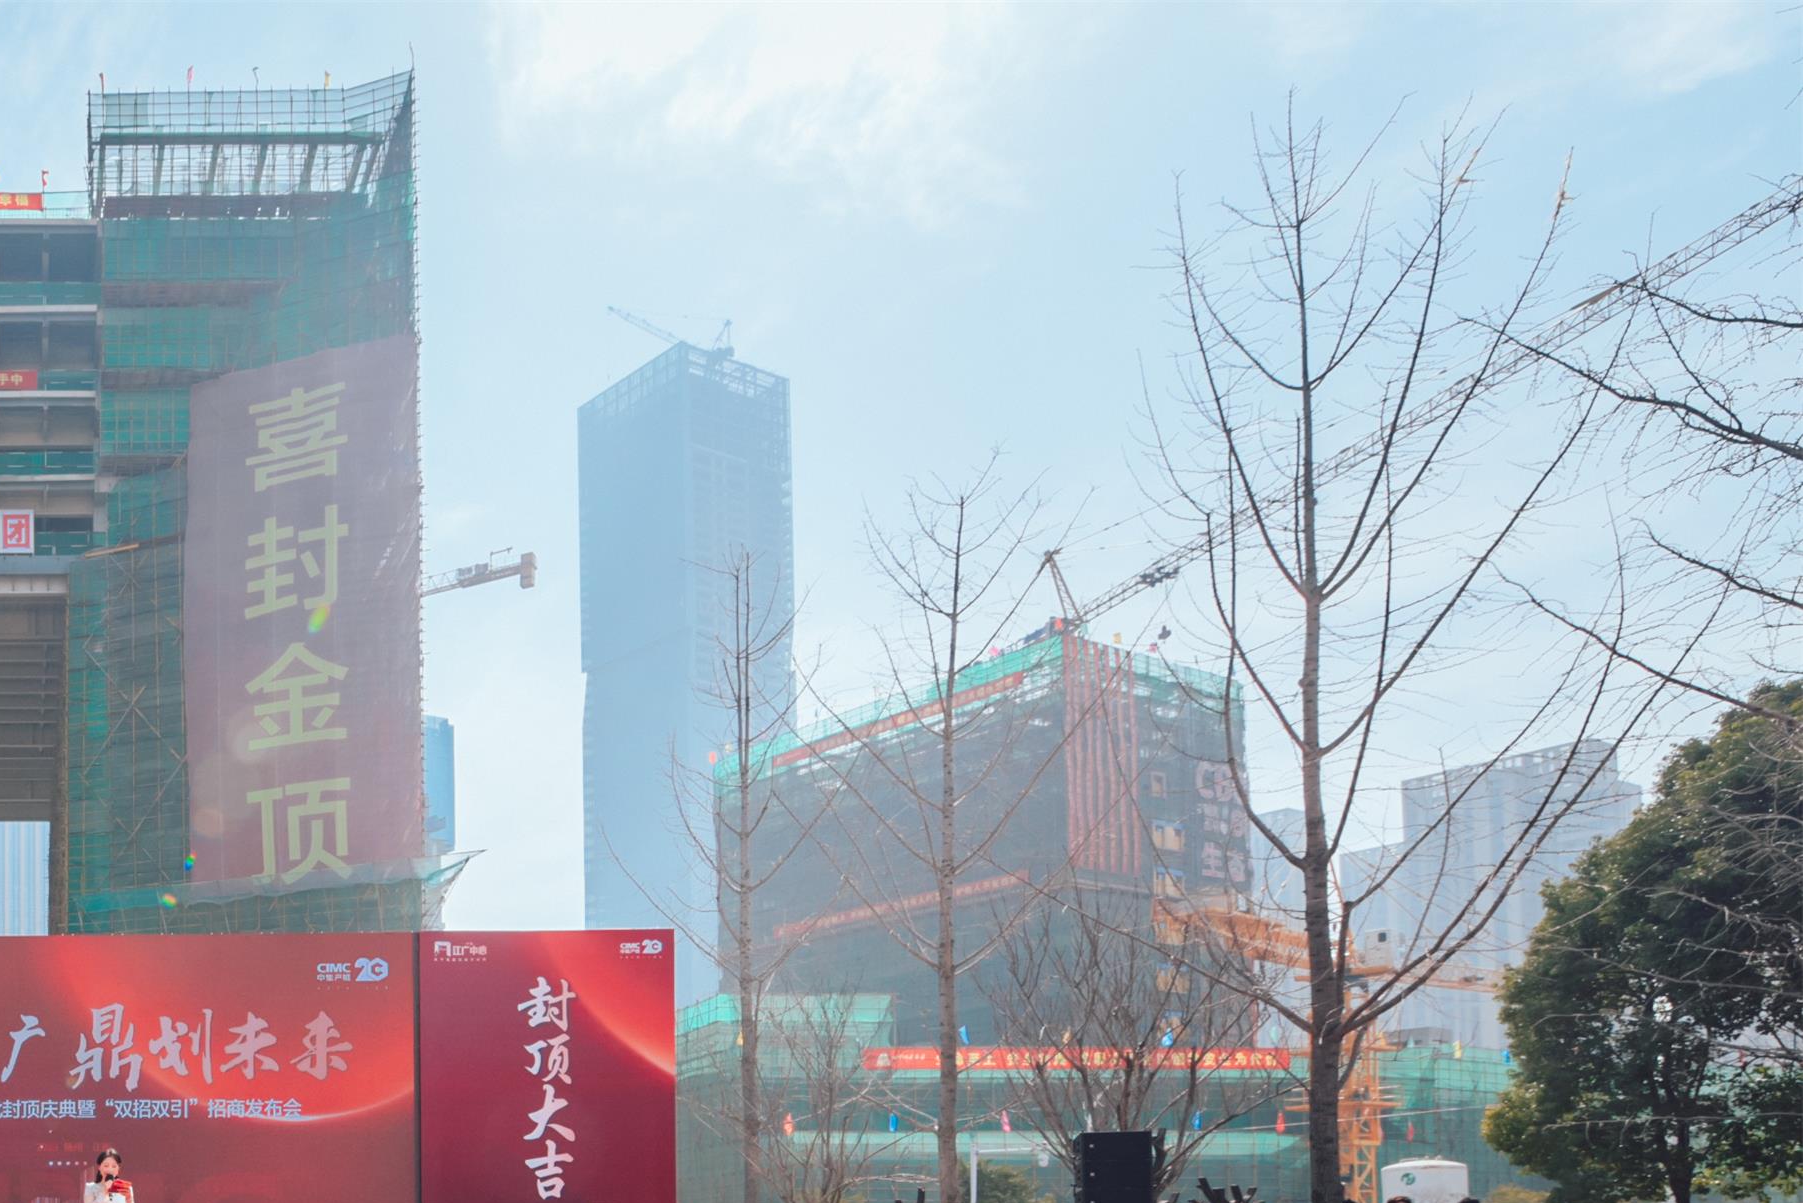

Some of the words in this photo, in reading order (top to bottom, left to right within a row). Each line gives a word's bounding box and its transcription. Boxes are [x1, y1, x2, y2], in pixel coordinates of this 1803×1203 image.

[243, 380, 352, 886] 喜封金顶
[317, 963, 351, 973] CIMC
[516, 976, 577, 1201] 封顶大吉
